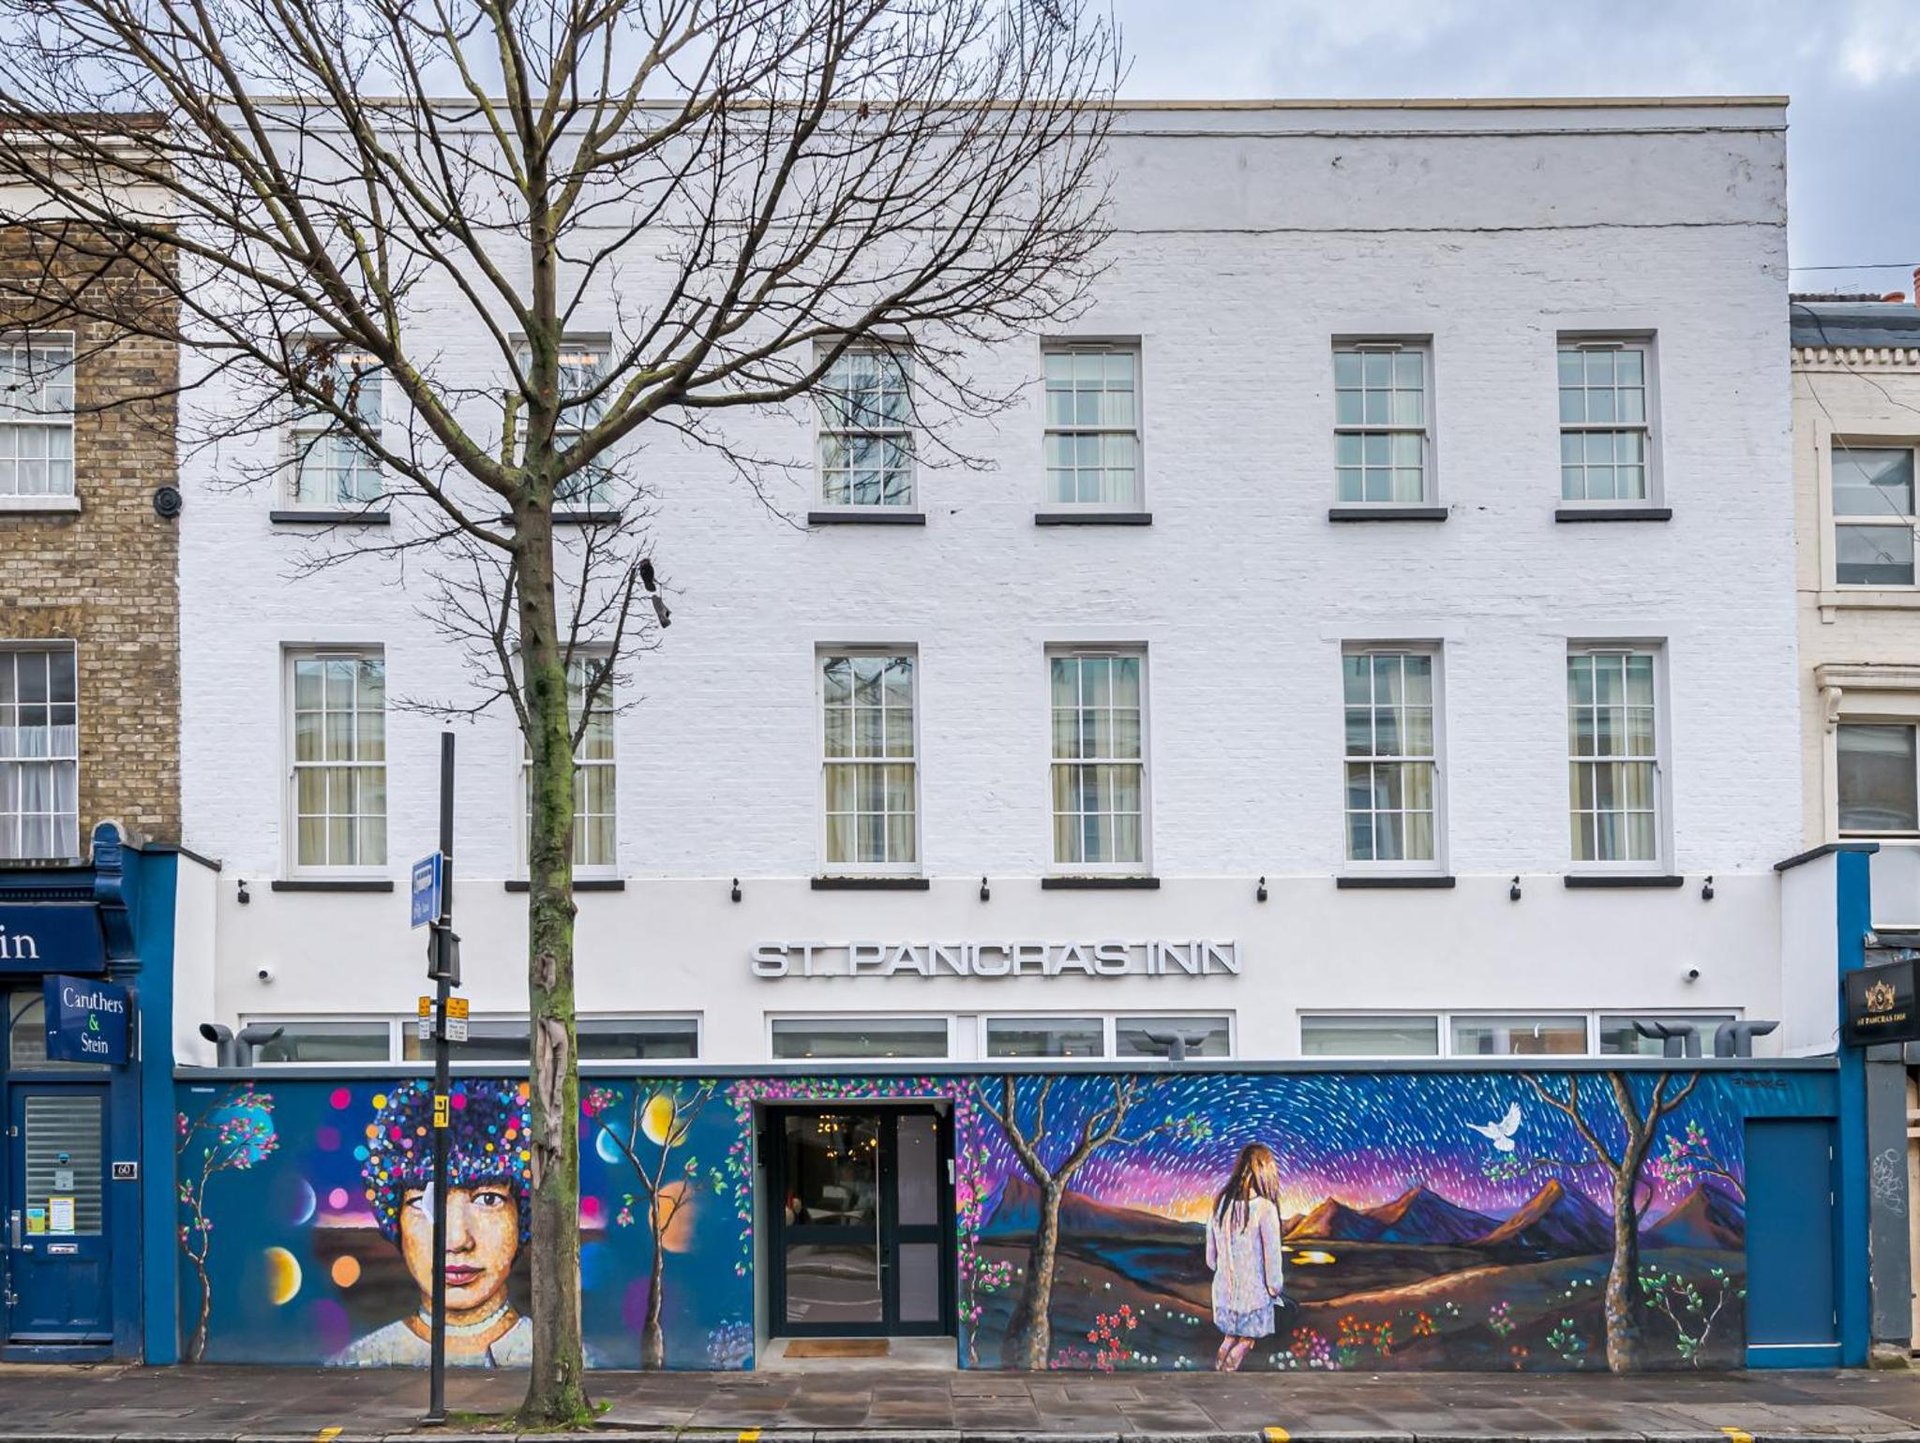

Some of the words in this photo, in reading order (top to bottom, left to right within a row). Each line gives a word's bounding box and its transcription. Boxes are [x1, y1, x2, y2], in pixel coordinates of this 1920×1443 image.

[849, 939, 1130, 977] PANCRAS
[1146, 939, 1240, 976] INN
[63, 987, 124, 1014] Caruthers
[89, 1013, 99, 1031] &
[81, 1032, 109, 1053] Stein
[118, 1164, 131, 1175] 60
